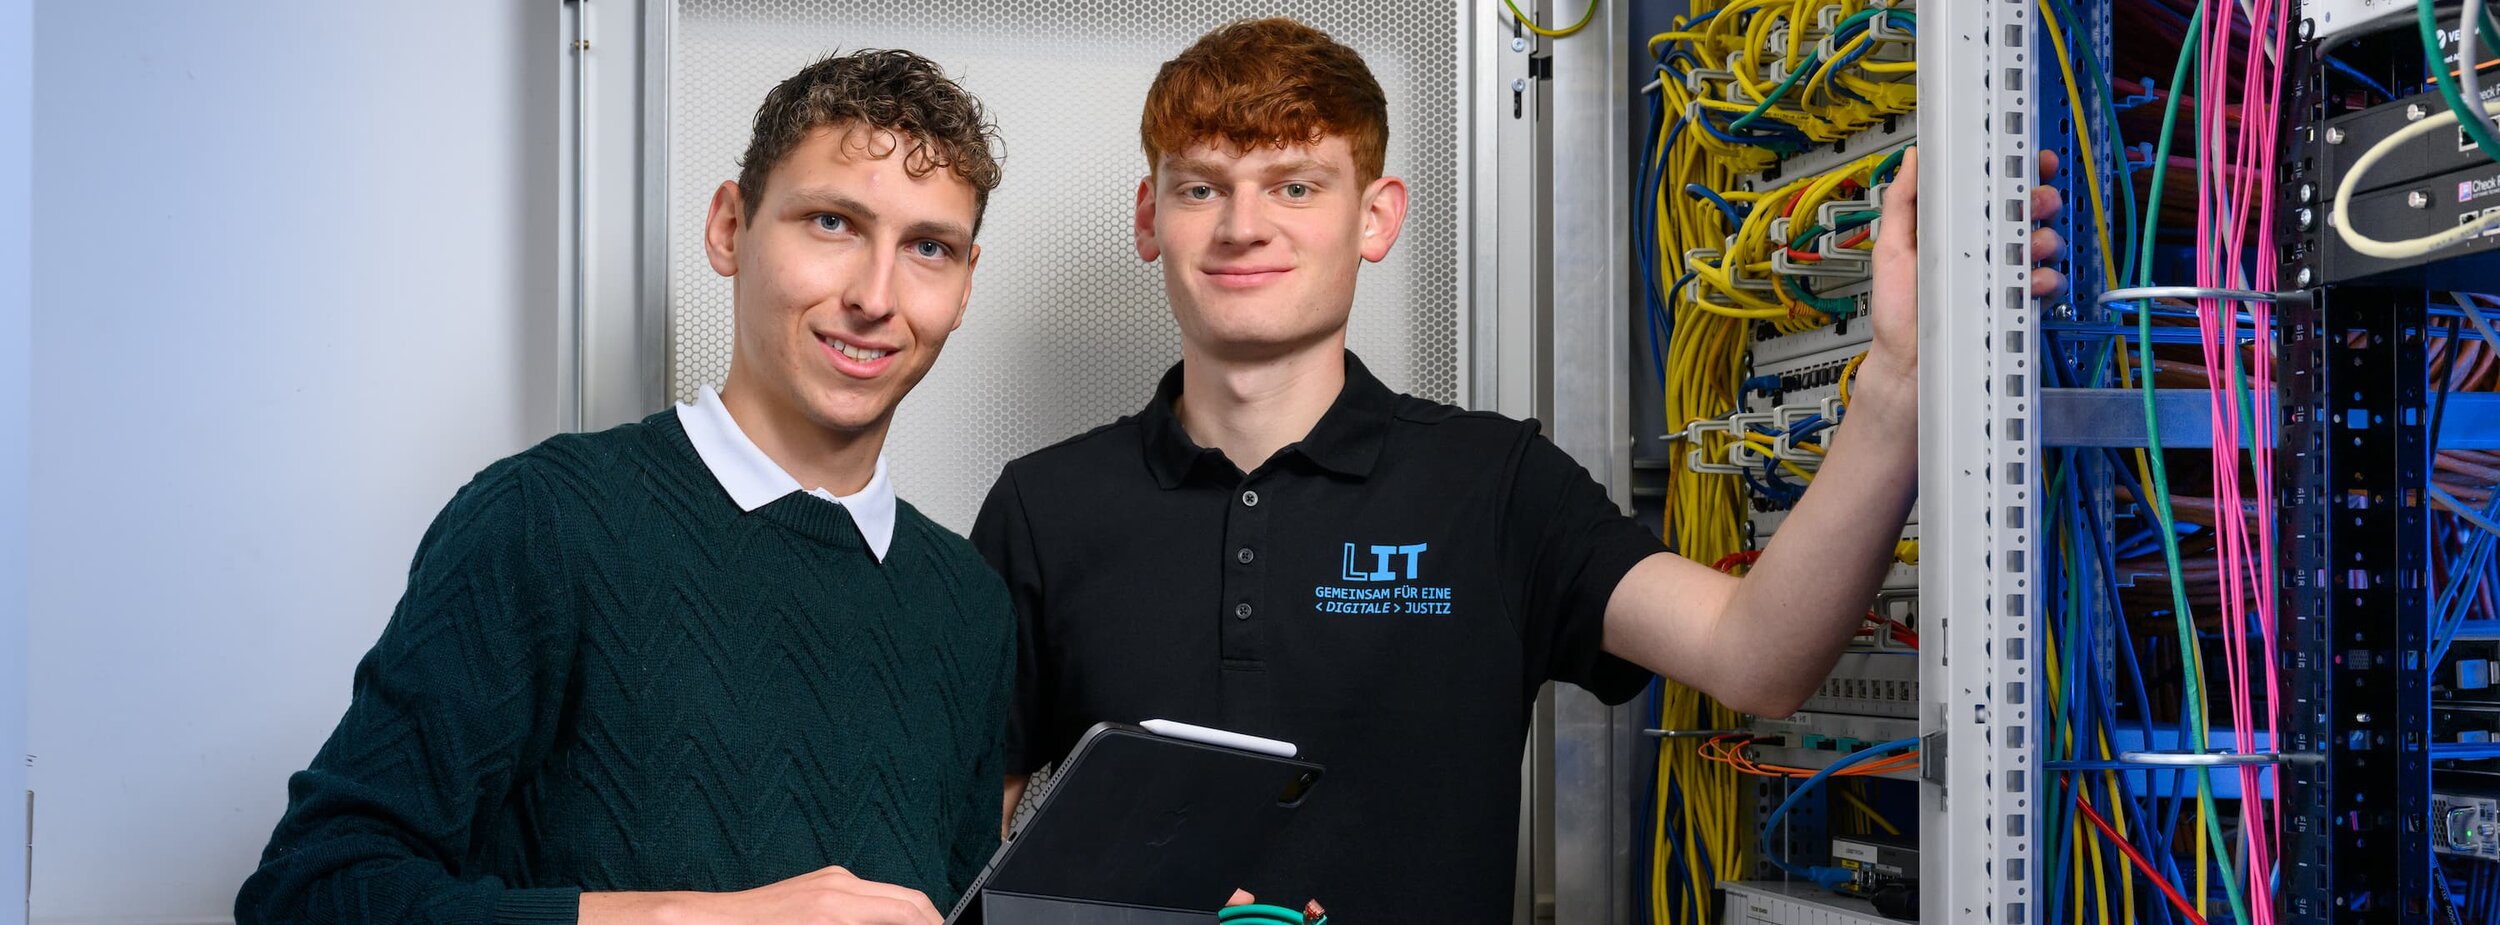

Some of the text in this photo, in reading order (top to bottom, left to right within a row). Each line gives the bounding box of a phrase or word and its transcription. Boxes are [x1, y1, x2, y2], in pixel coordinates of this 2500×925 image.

[2472, 176, 2496, 193] Check
[1342, 542, 1428, 581] LIT
[1315, 584, 1452, 600] GEMEINSAM FÜR EINE
[1325, 601, 1391, 614] DIGITALE
[1405, 602, 1452, 615] JUSTIZ
